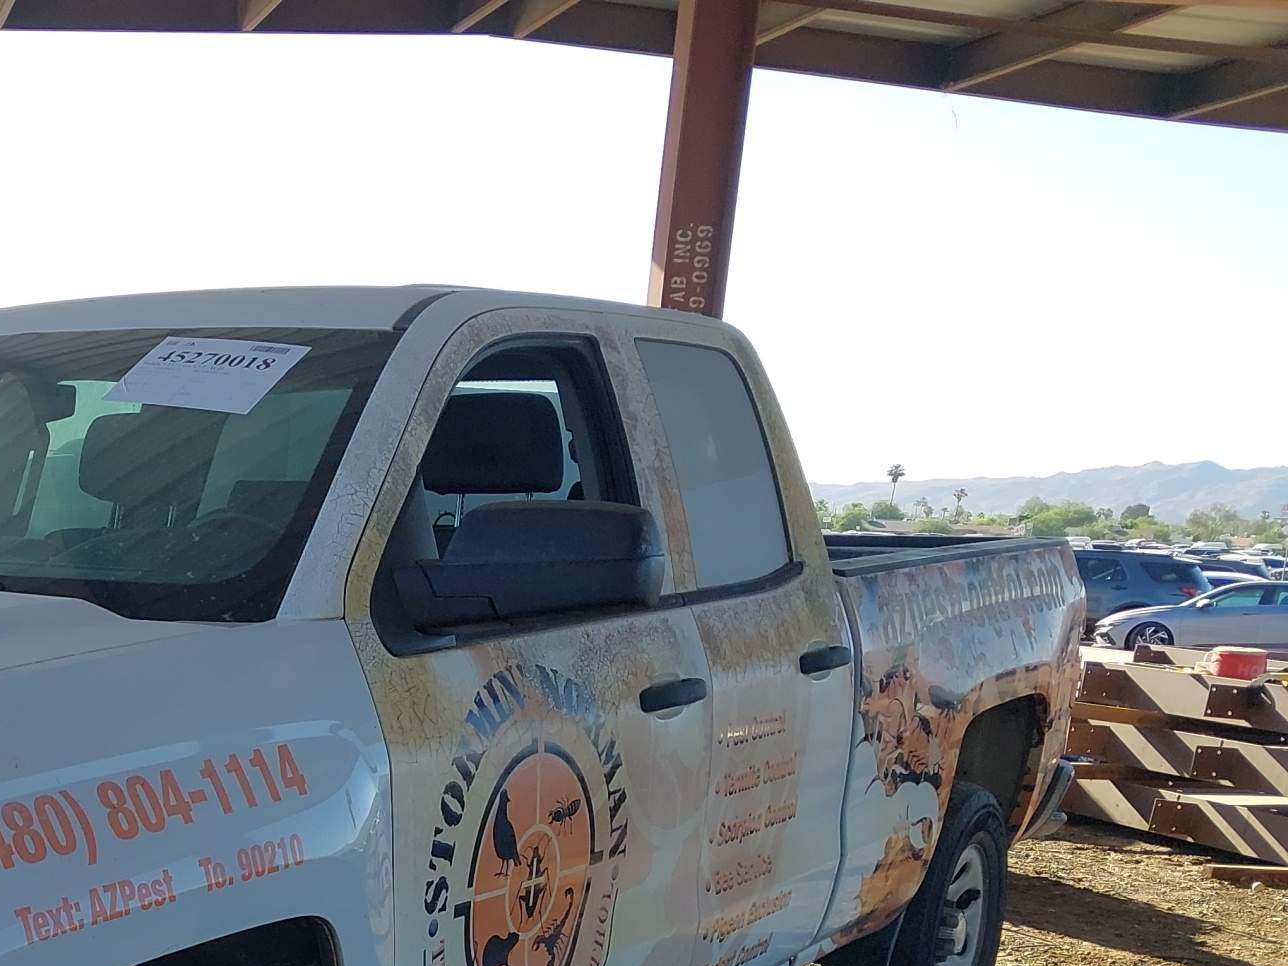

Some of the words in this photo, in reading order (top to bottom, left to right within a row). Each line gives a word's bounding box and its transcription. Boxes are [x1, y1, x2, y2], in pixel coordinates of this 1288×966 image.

[673, 223, 694, 263] INC.
[669, 276, 687, 308] AB
[158, 349, 277, 371] 45270018
[751, 711, 786, 741] Control
[96, 743, 309, 841] 804-1114
[723, 765, 761, 797] Termite
[763, 752, 797, 785] Control
[763, 800, 796, 829] Control
[14, 896, 86, 945] Text:
[90, 868, 177, 927] AZPest
[237, 833, 304, 881] 90210
[713, 871, 734, 895] Bee
[736, 855, 773, 886] Service
